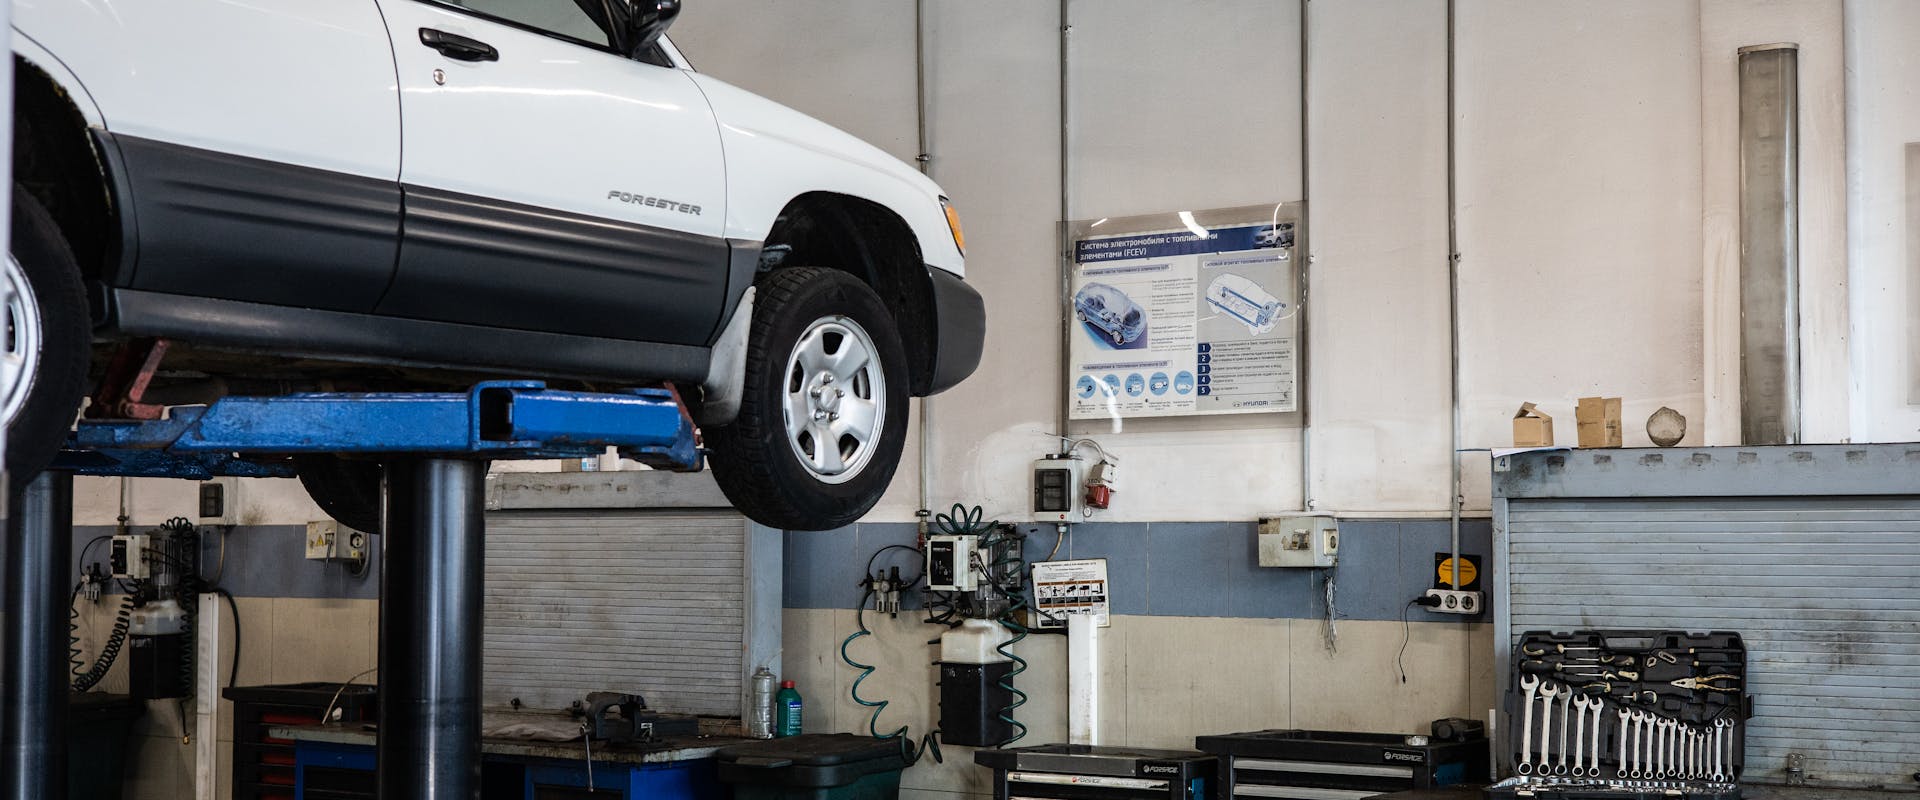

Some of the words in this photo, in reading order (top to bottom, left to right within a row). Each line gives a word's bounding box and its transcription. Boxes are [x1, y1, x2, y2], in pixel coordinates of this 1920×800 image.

[607, 190, 703, 216] FORESTER
[1080, 242, 1109, 250] Система
[1110, 236, 1164, 248] электромобиля
[1080, 252, 1122, 260] элементами
[1123, 247, 1147, 257] (FCEV)
[1499, 458, 1506, 467] 4
